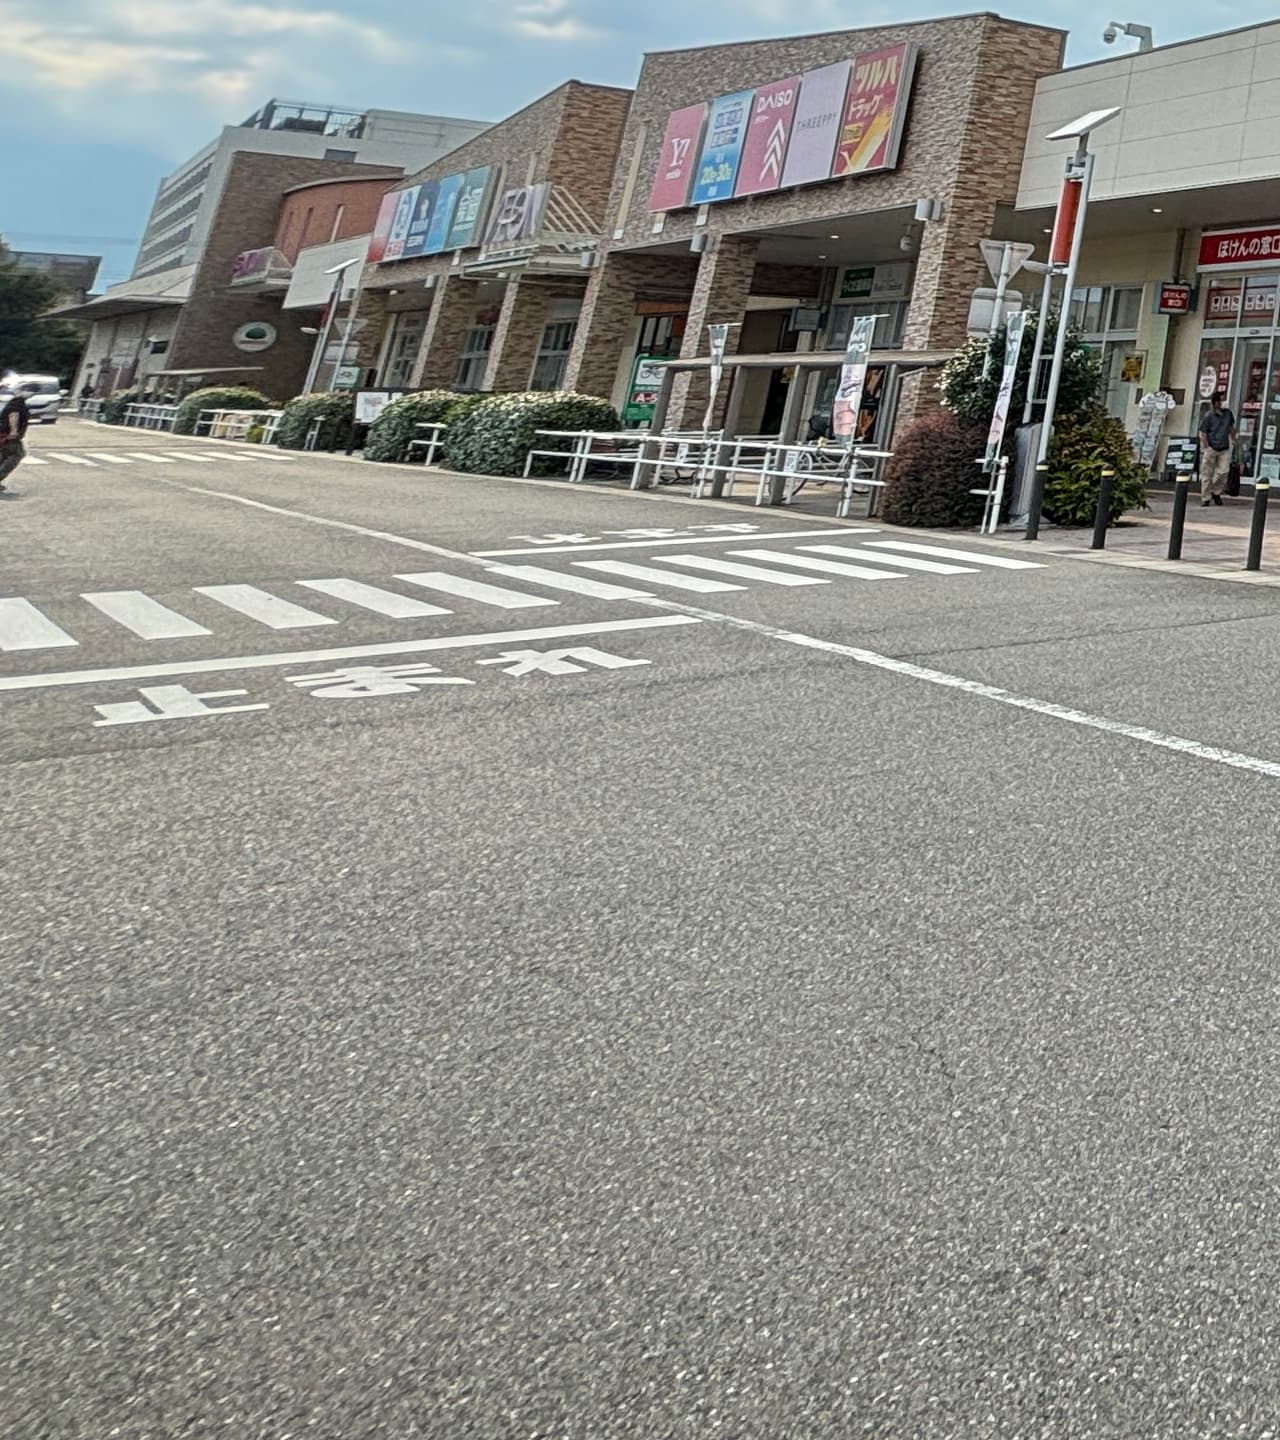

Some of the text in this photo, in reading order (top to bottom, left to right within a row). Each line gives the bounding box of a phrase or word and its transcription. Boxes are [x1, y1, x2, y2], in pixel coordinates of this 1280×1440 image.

[855, 56, 899, 95] ツルハ
[757, 89, 793, 113] DAISO
[848, 94, 884, 122] ドラッグ
[93, 646, 652, 728] 止まれ
